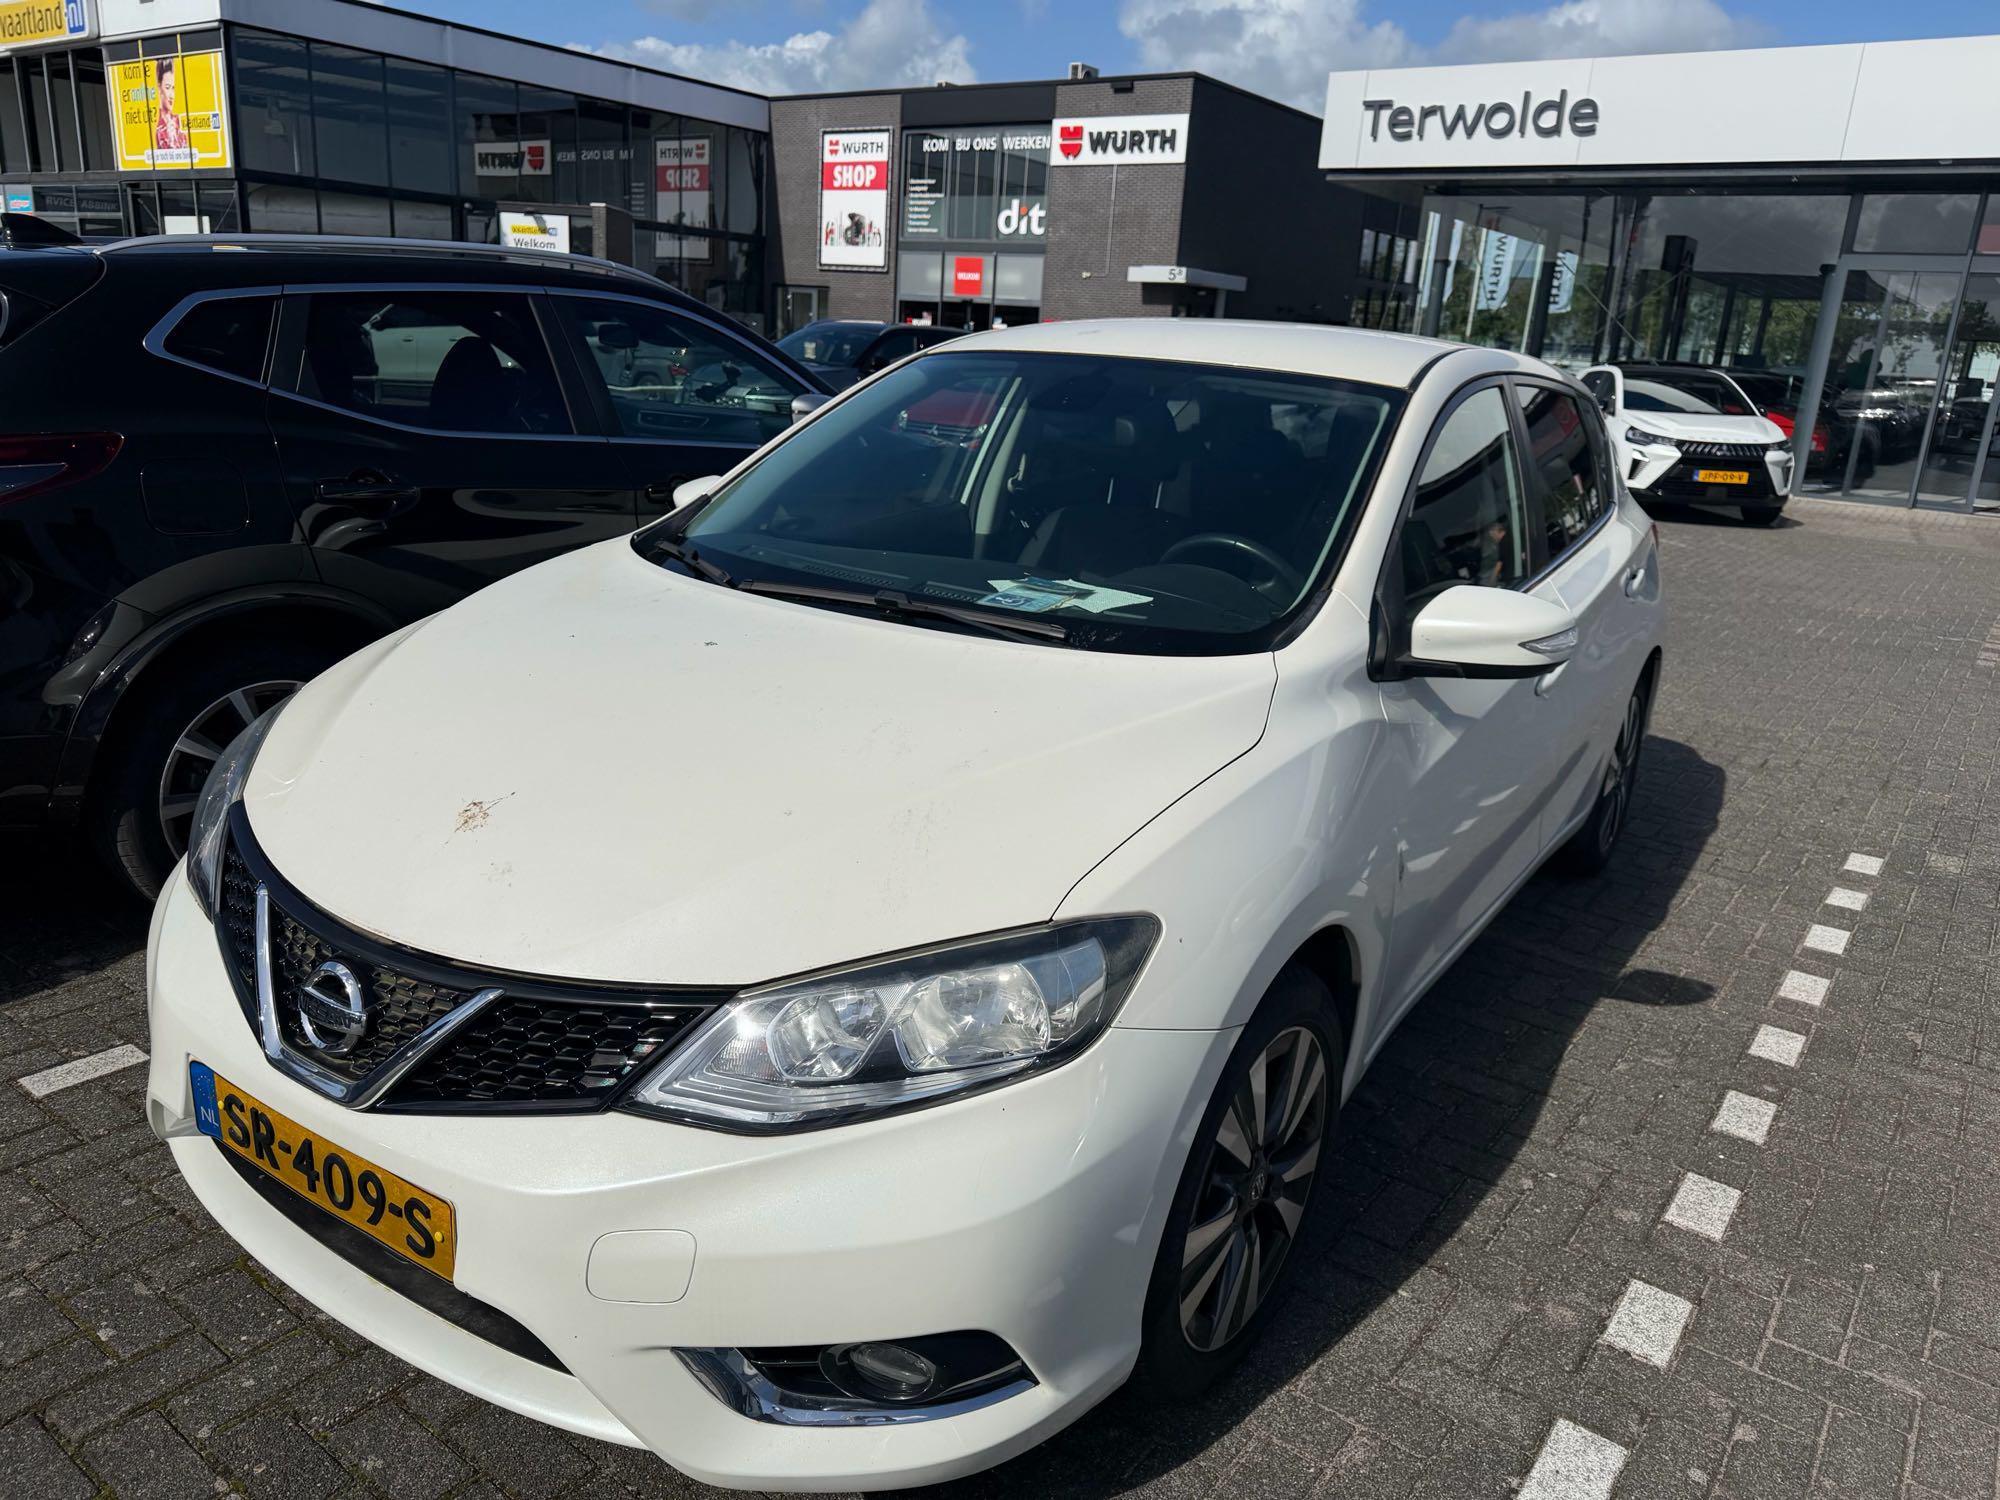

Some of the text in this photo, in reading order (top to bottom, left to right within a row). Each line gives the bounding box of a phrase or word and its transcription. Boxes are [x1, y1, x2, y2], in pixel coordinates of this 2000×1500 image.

[143, 107, 158, 124] ut?
[1363, 89, 1599, 142] Terwolde
[923, 139, 949, 152] KOM
[973, 137, 997, 150] ONS
[1002, 136, 1051, 150] WERKEN
[1089, 129, 1176, 154] WÜRTH
[833, 164, 877, 188] SHOP
[997, 199, 1046, 235] dit
[513, 238, 556, 249] Welkom
[200, 1106, 219, 1128] NL
[223, 1094, 436, 1258] SR-409-S
